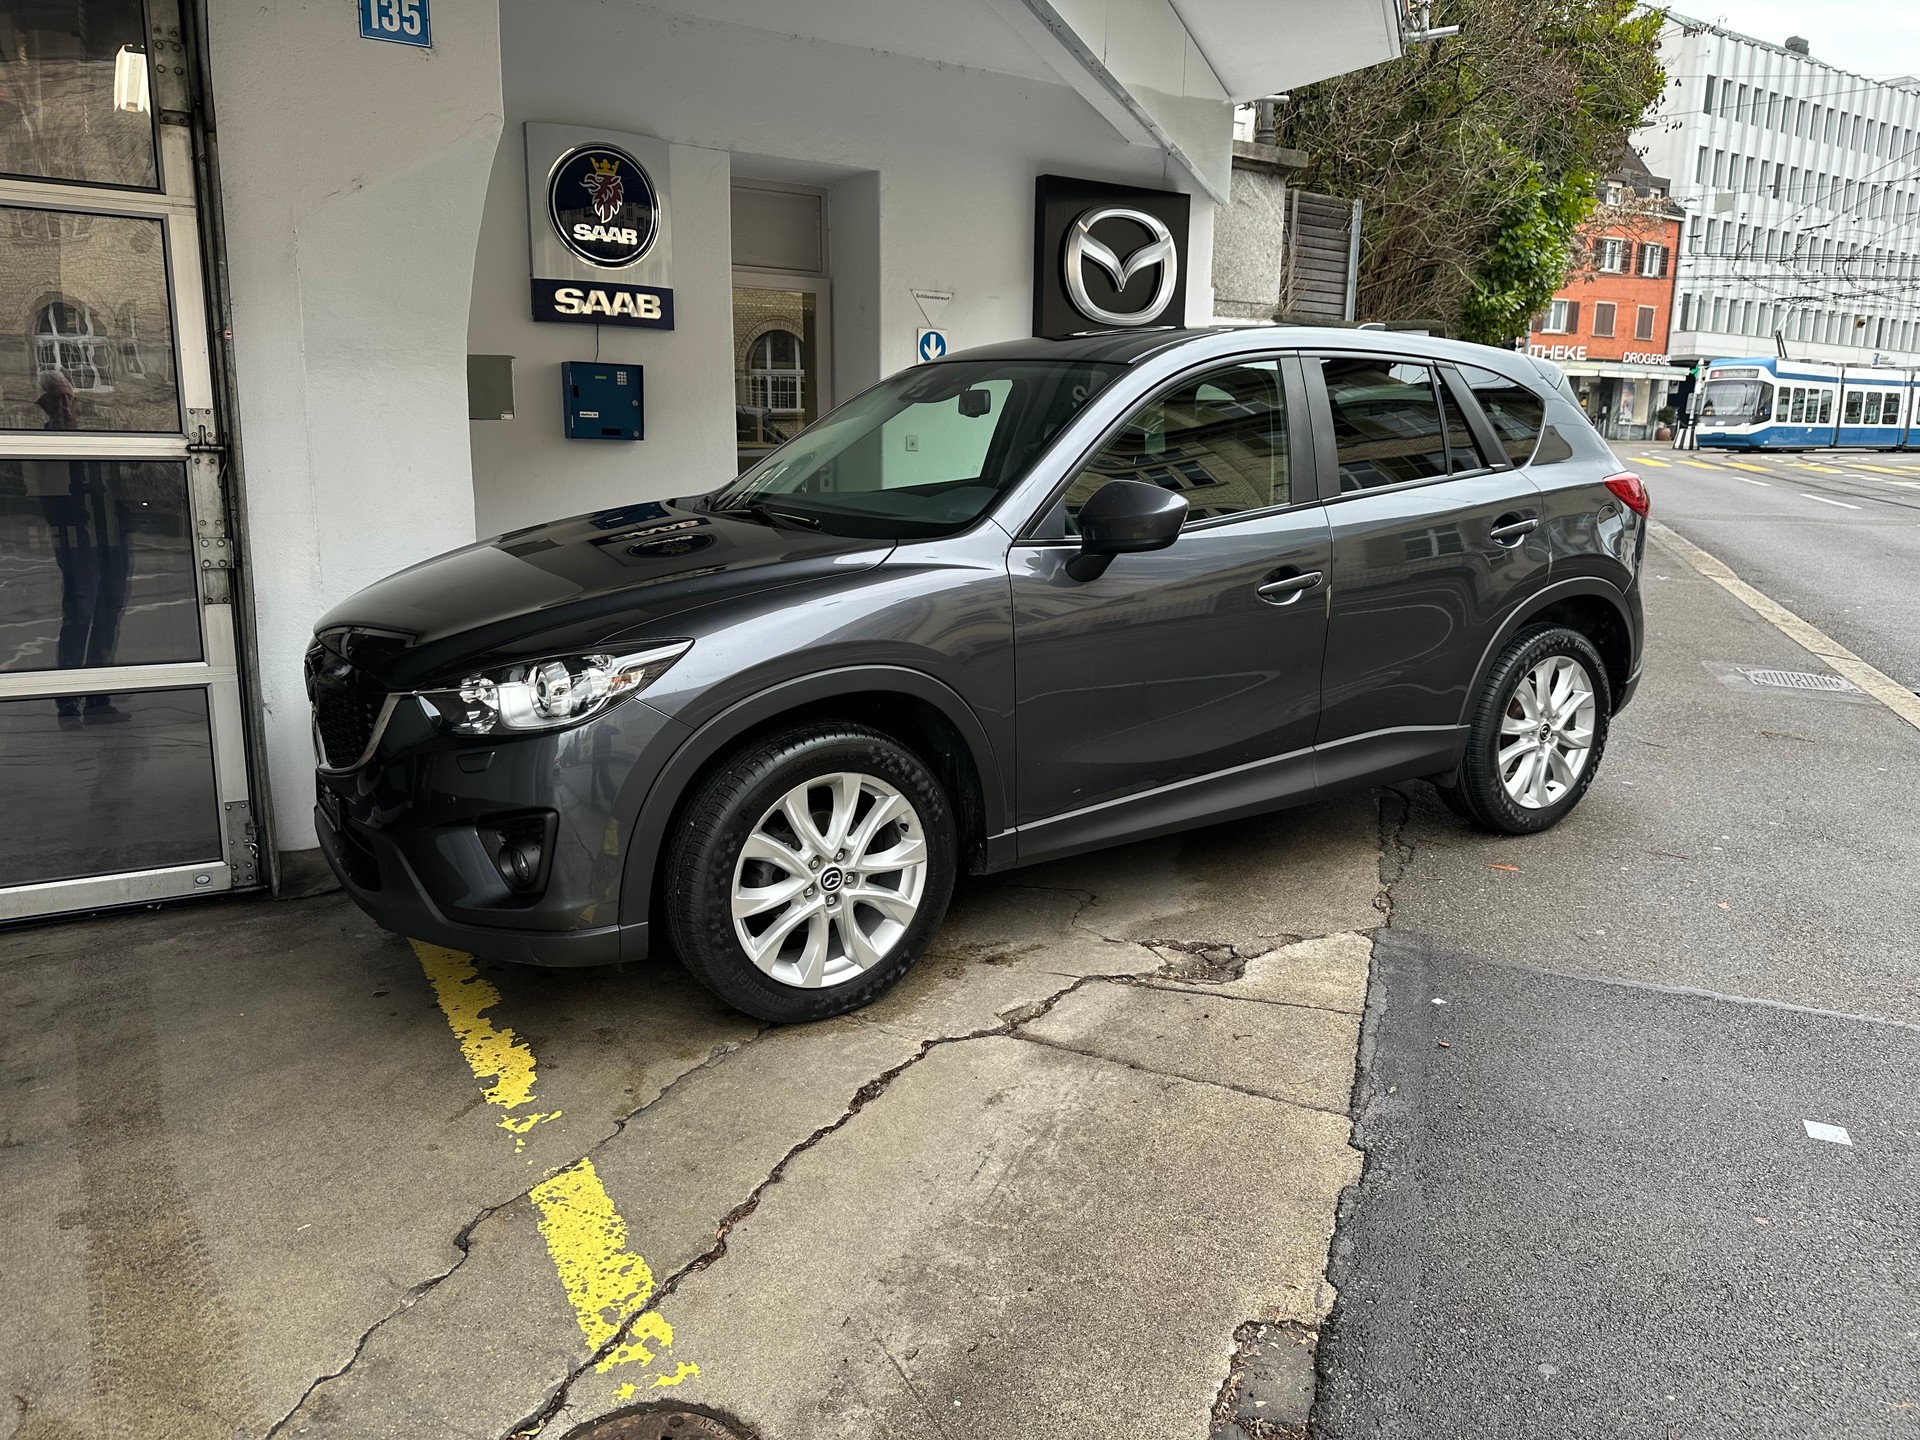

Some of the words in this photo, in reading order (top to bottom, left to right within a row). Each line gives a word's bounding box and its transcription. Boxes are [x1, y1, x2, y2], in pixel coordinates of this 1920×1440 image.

[370, 0, 421, 35] 135
[573, 223, 638, 246] SAAB
[554, 287, 662, 320] SAAB
[1622, 352, 1672, 366] DROGERIE
